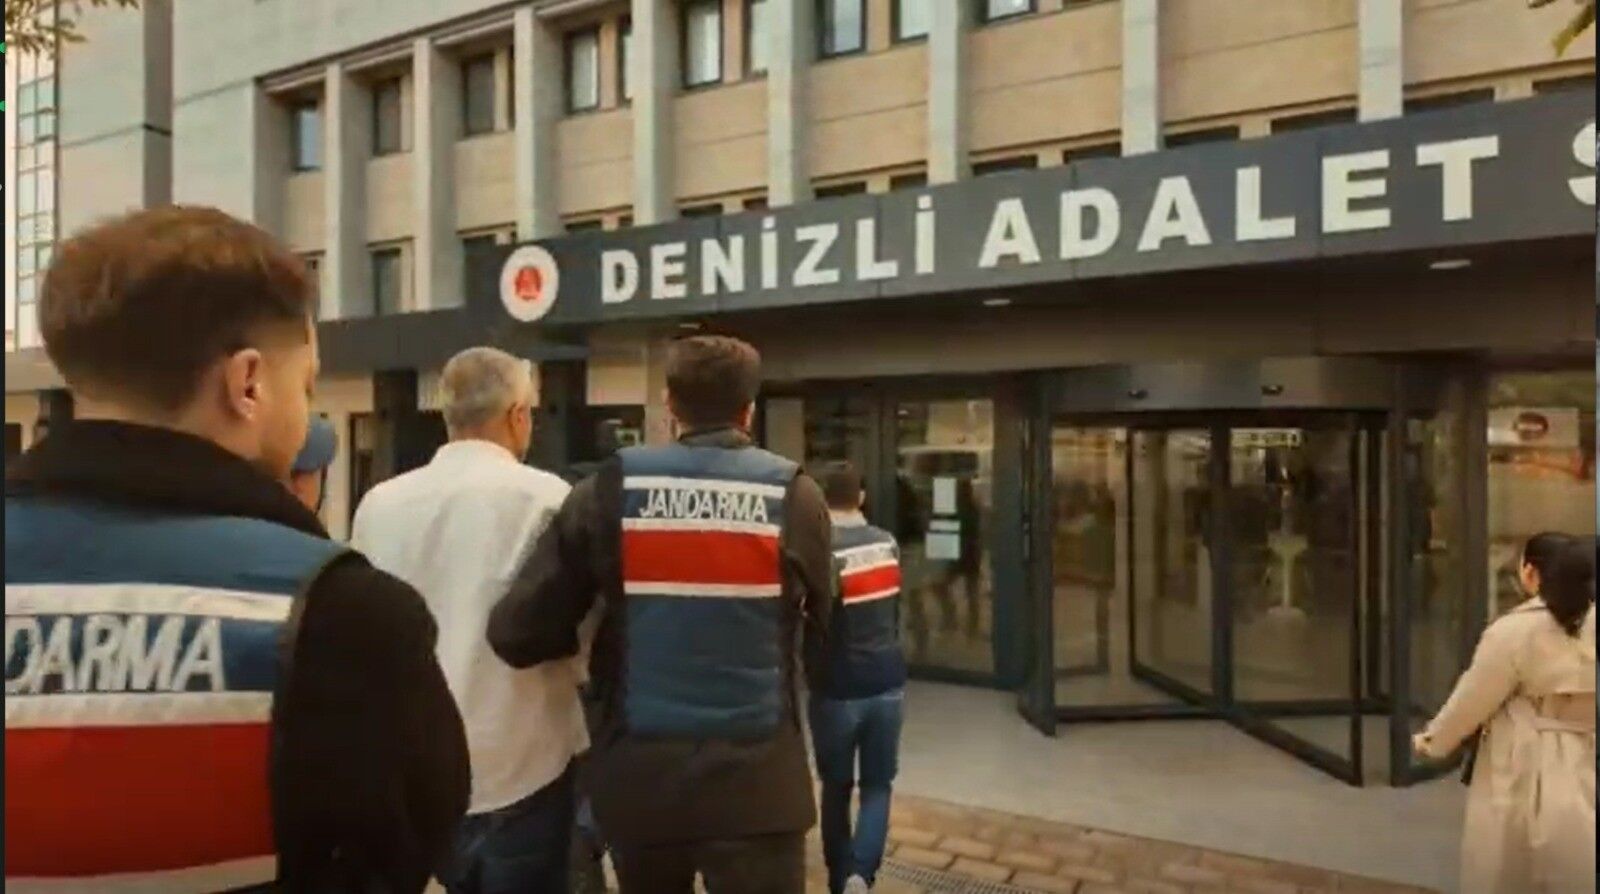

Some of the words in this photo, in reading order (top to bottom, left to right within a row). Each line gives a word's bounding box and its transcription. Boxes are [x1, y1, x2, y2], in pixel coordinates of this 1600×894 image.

[601, 195, 935, 305] DENİZLİ
[978, 134, 1499, 268] ADALET
[639, 488, 768, 524] JANDARMA
